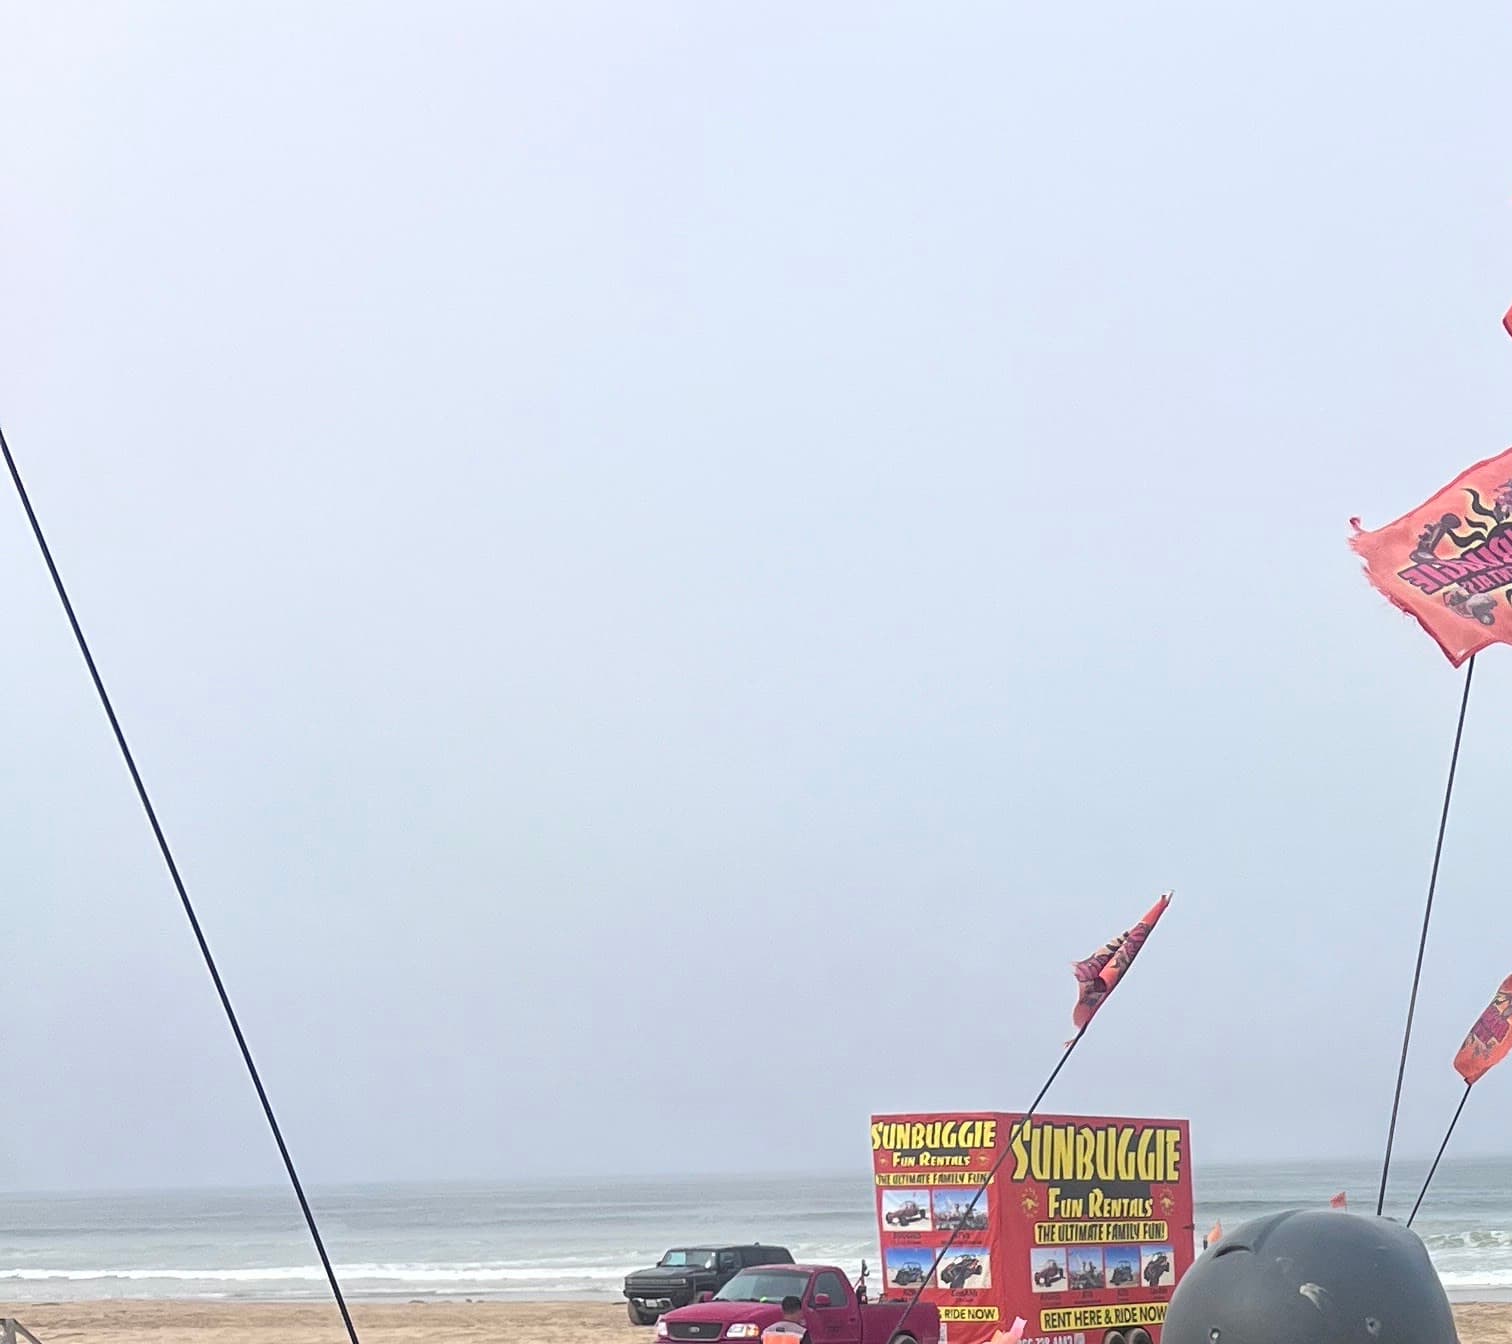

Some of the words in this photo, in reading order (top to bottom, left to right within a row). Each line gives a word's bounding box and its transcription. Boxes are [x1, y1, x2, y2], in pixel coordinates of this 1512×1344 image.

[871, 1120, 997, 1150] SUNBUGGIE
[892, 1152, 915, 1168] FUN
[919, 1151, 971, 1167] RENTALS
[1010, 1120, 1181, 1182] SUNBUGGIE
[968, 1173, 990, 1185] FUN
[1047, 1187, 1083, 1219] FUN
[1088, 1187, 1153, 1219] RENTALS
[1037, 1223, 1055, 1241] THE
[1058, 1223, 1103, 1241] ULTIMATE
[1106, 1223, 1139, 1240] FAMILY
[1143, 1222, 1164, 1239] FUN!
[944, 1308, 966, 1320] RIDE
[968, 1308, 996, 1319] NOW
[1044, 1311, 1072, 1329] RENT
[1074, 1309, 1102, 1327] HERE
[1104, 1309, 1113, 1325] &
[1115, 1307, 1138, 1323] RIDE
